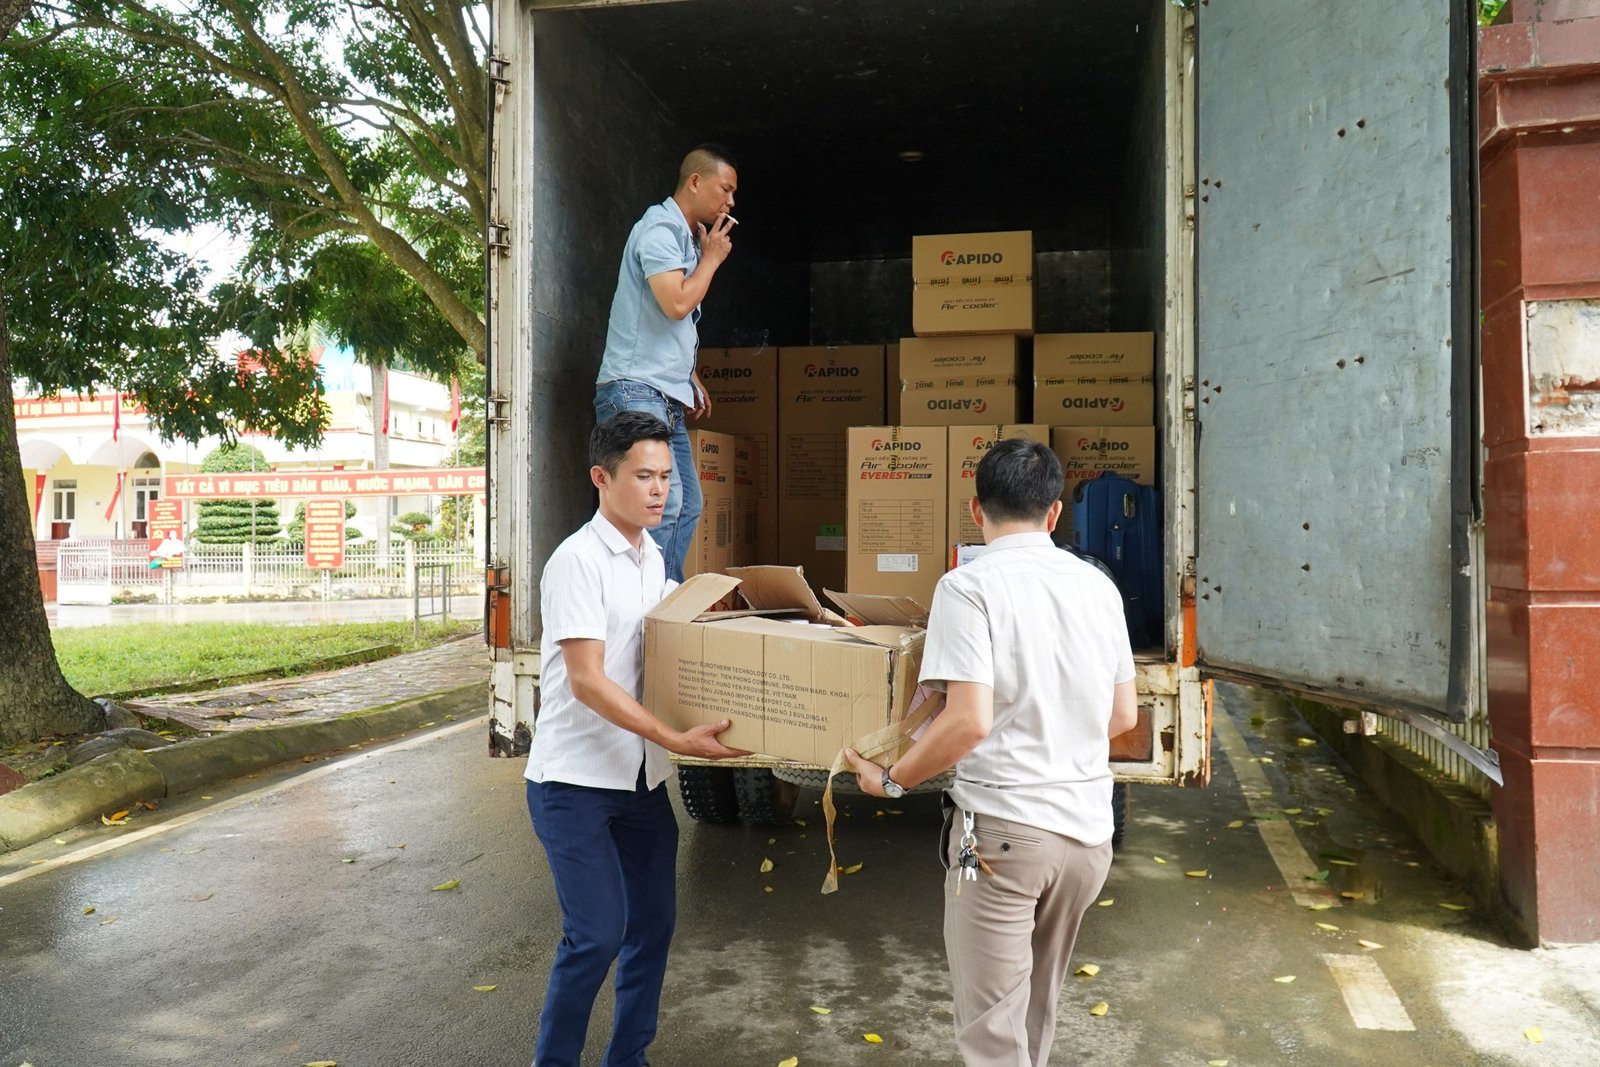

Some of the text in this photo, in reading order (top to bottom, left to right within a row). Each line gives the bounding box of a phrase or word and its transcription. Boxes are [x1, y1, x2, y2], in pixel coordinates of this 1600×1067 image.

[941, 250, 1002, 266] RAPIDO
[701, 366, 752, 379] RAPIDO
[804, 364, 859, 377] RAPIDO
[928, 399, 987, 413] RAPIDO
[1062, 398, 1124, 412] RAPIDO
[872, 439, 921, 451] RAPIDO
[1077, 438, 1129, 450] RAPIDO
[175, 478, 195, 493] TẤT
[199, 477, 215, 493] CẢ
[218, 479, 230, 493] VÌ
[233, 480, 260, 495] MỤC
[263, 479, 289, 492] TIÊU
[293, 478, 317, 492] DÂN
[356, 475, 389, 491] NƯỚC
[438, 474, 464, 488] DÂN
